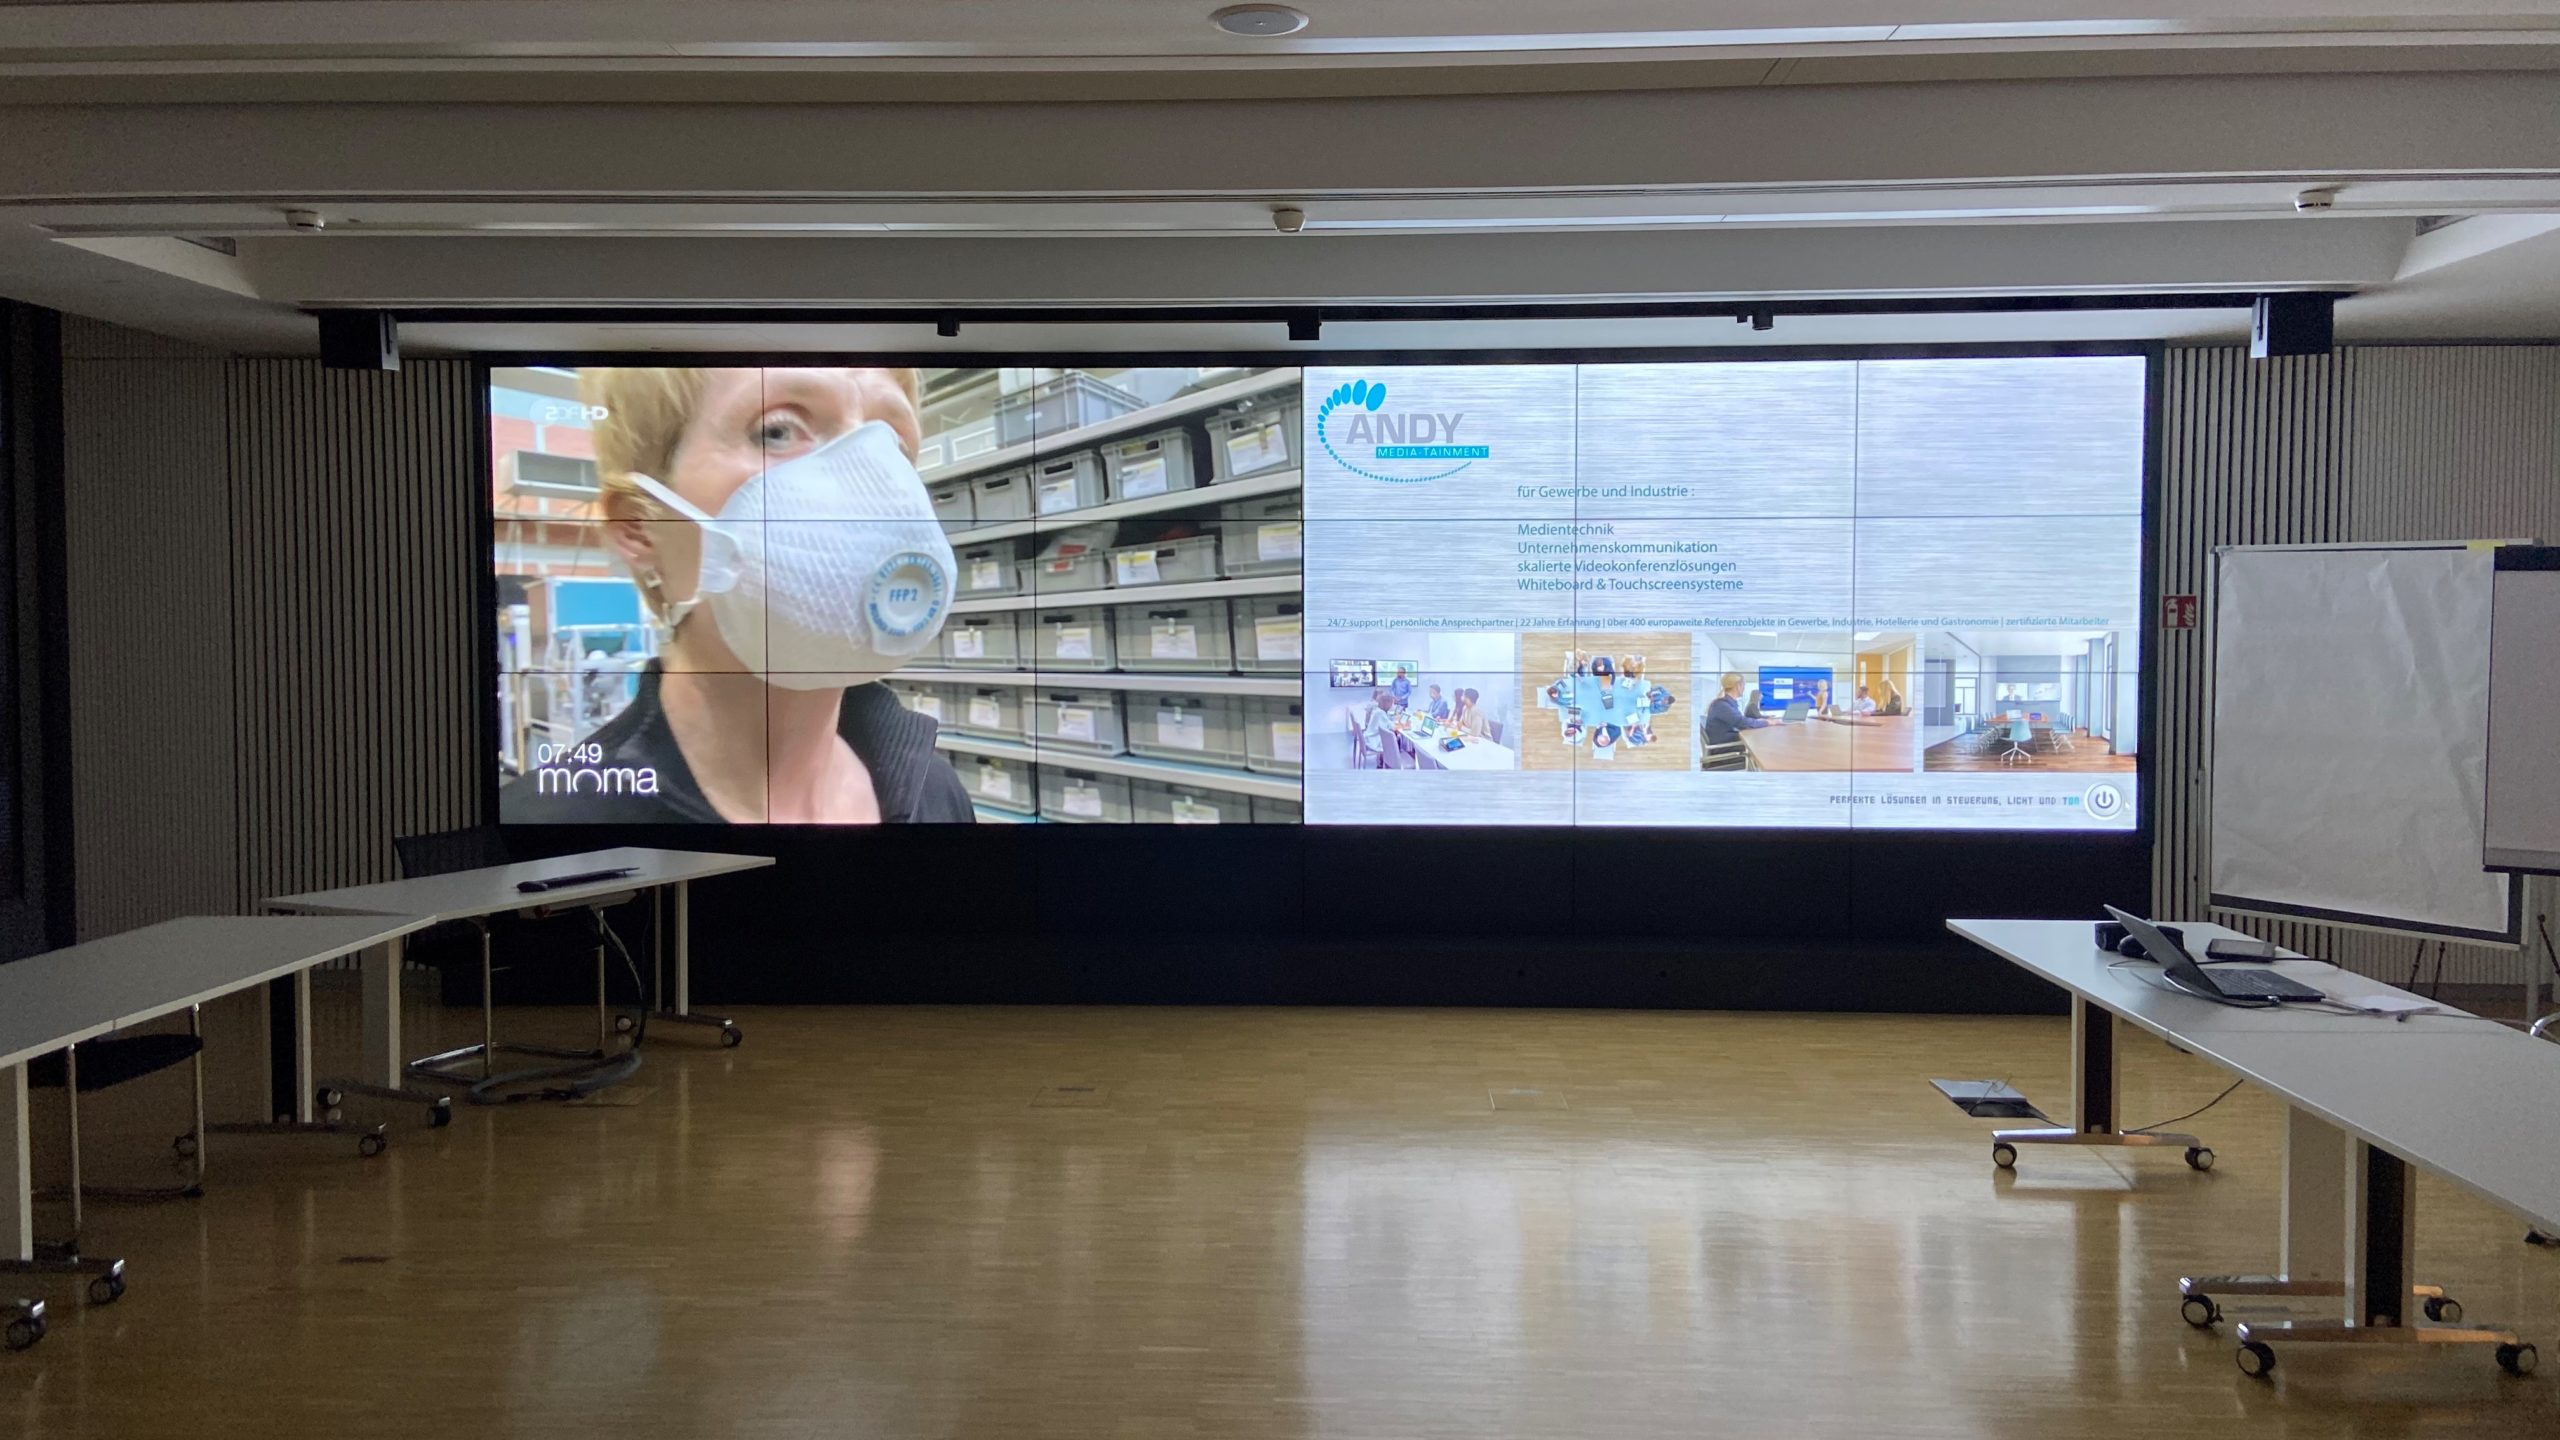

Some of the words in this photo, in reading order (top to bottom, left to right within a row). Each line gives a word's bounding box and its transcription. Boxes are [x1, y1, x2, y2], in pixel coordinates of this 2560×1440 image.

[581, 406, 609, 421] HD
[1345, 413, 1465, 445] ANDY
[1517, 485, 1536, 498] für
[1538, 485, 1599, 498] Gewerbe
[1601, 485, 1628, 497] und
[1630, 485, 1689, 497] Industrie
[1517, 523, 1615, 536] Medientechnik
[1517, 541, 1718, 554] Unternehmenskommunikation
[1517, 560, 1572, 573] skalierte
[1574, 560, 1737, 575] Videokonferenzlösungen
[1517, 579, 1594, 591] Whiteboard
[1596, 580, 1607, 591] &
[1609, 578, 1744, 593] Touchscreensysteme
[889, 588, 919, 603] FFP2
[1389, 617, 1440, 629] persönliche
[1441, 617, 1515, 629] Ansprechpartner
[1520, 618, 1531, 627] 22
[1532, 617, 1556, 627] Jahre
[1557, 617, 1601, 629] Erfahrung
[1607, 617, 1628, 627] über
[1629, 618, 1646, 627] 400
[1647, 617, 1705, 629] europaweite
[1705, 617, 1775, 629] Referenzobjekte
[1787, 617, 1830, 628] Gewerbe,
[1875, 617, 1919, 627] Hotellerie
[1921, 617, 1939, 627] und
[1941, 617, 1999, 627] Gastronomie
[2005, 617, 2057, 627] zertifizierte
[2058, 617, 2110, 627] Mitarbeiter
[538, 743, 603, 764] 07:49
[538, 767, 660, 795] moma
[1829, 795, 1876, 805] PERFEKTE
[1880, 793, 1927, 805] LÖSUNGEN
[1932, 796, 1942, 805] IN
[2007, 796, 2033, 805] LICHT
[2039, 796, 2057, 805] UND
[2063, 796, 2081, 806] TON
